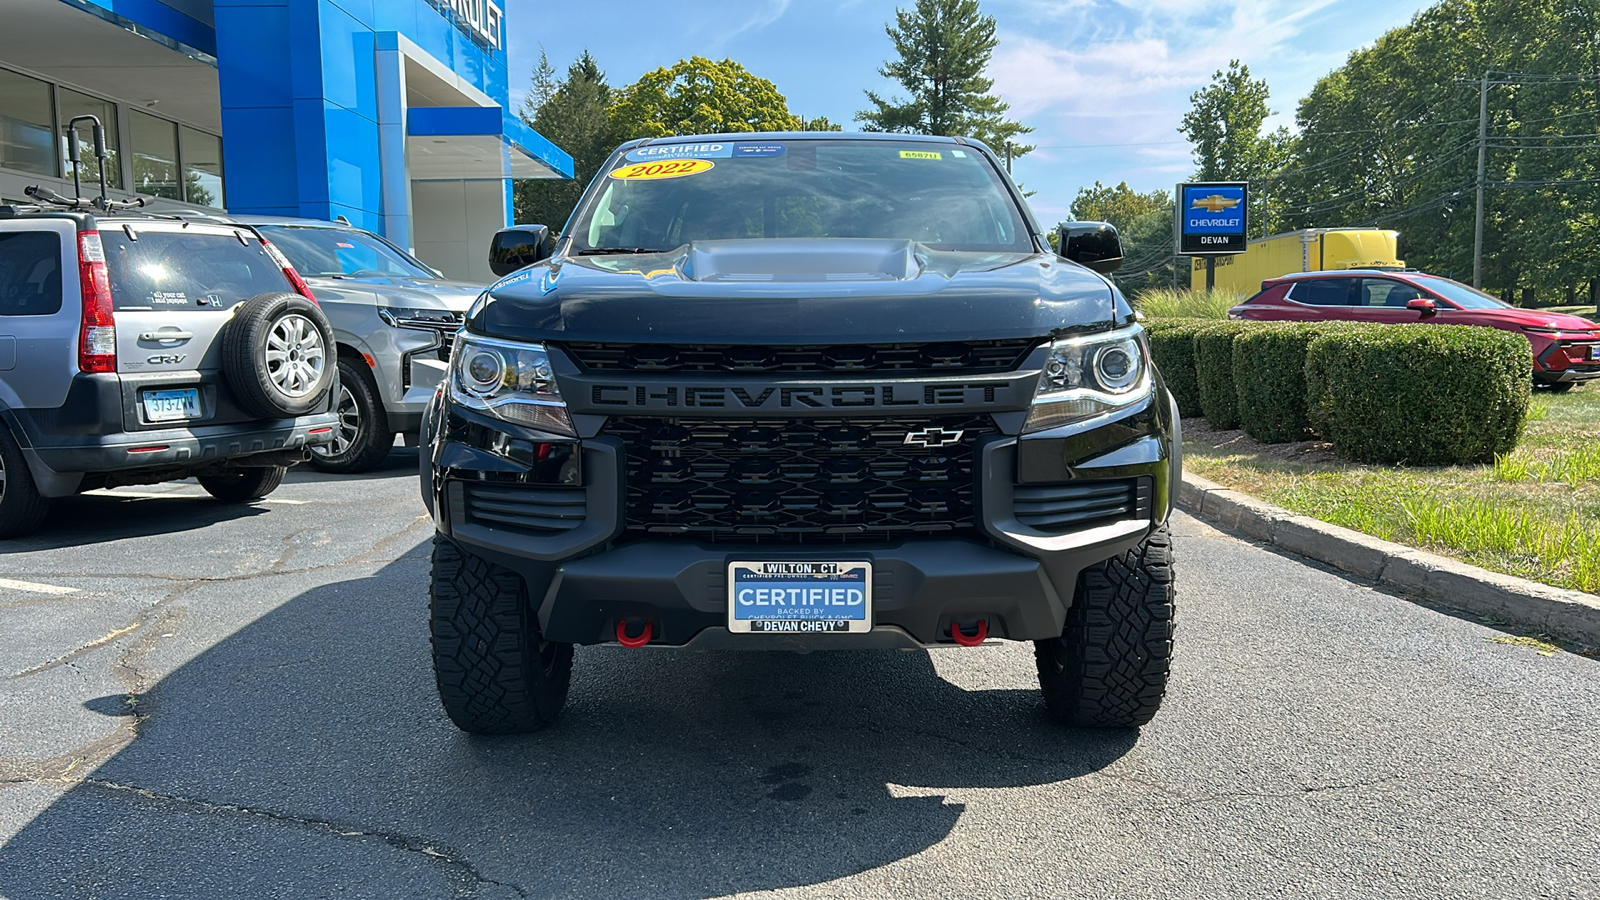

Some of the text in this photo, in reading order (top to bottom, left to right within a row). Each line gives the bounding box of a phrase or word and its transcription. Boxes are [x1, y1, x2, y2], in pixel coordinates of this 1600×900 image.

[637, 144, 723, 156] CERTIFIED
[626, 161, 697, 178] 2022
[1190, 218, 1240, 227] CHEVROLET
[1201, 236, 1229, 244] DEVAN
[147, 353, 187, 365] CR-V
[591, 383, 1010, 408] CHEVROLET
[767, 563, 836, 574] WILTON, CT
[738, 588, 863, 606] CERTIFIED
[763, 621, 836, 631] DEVAN CHEVY
